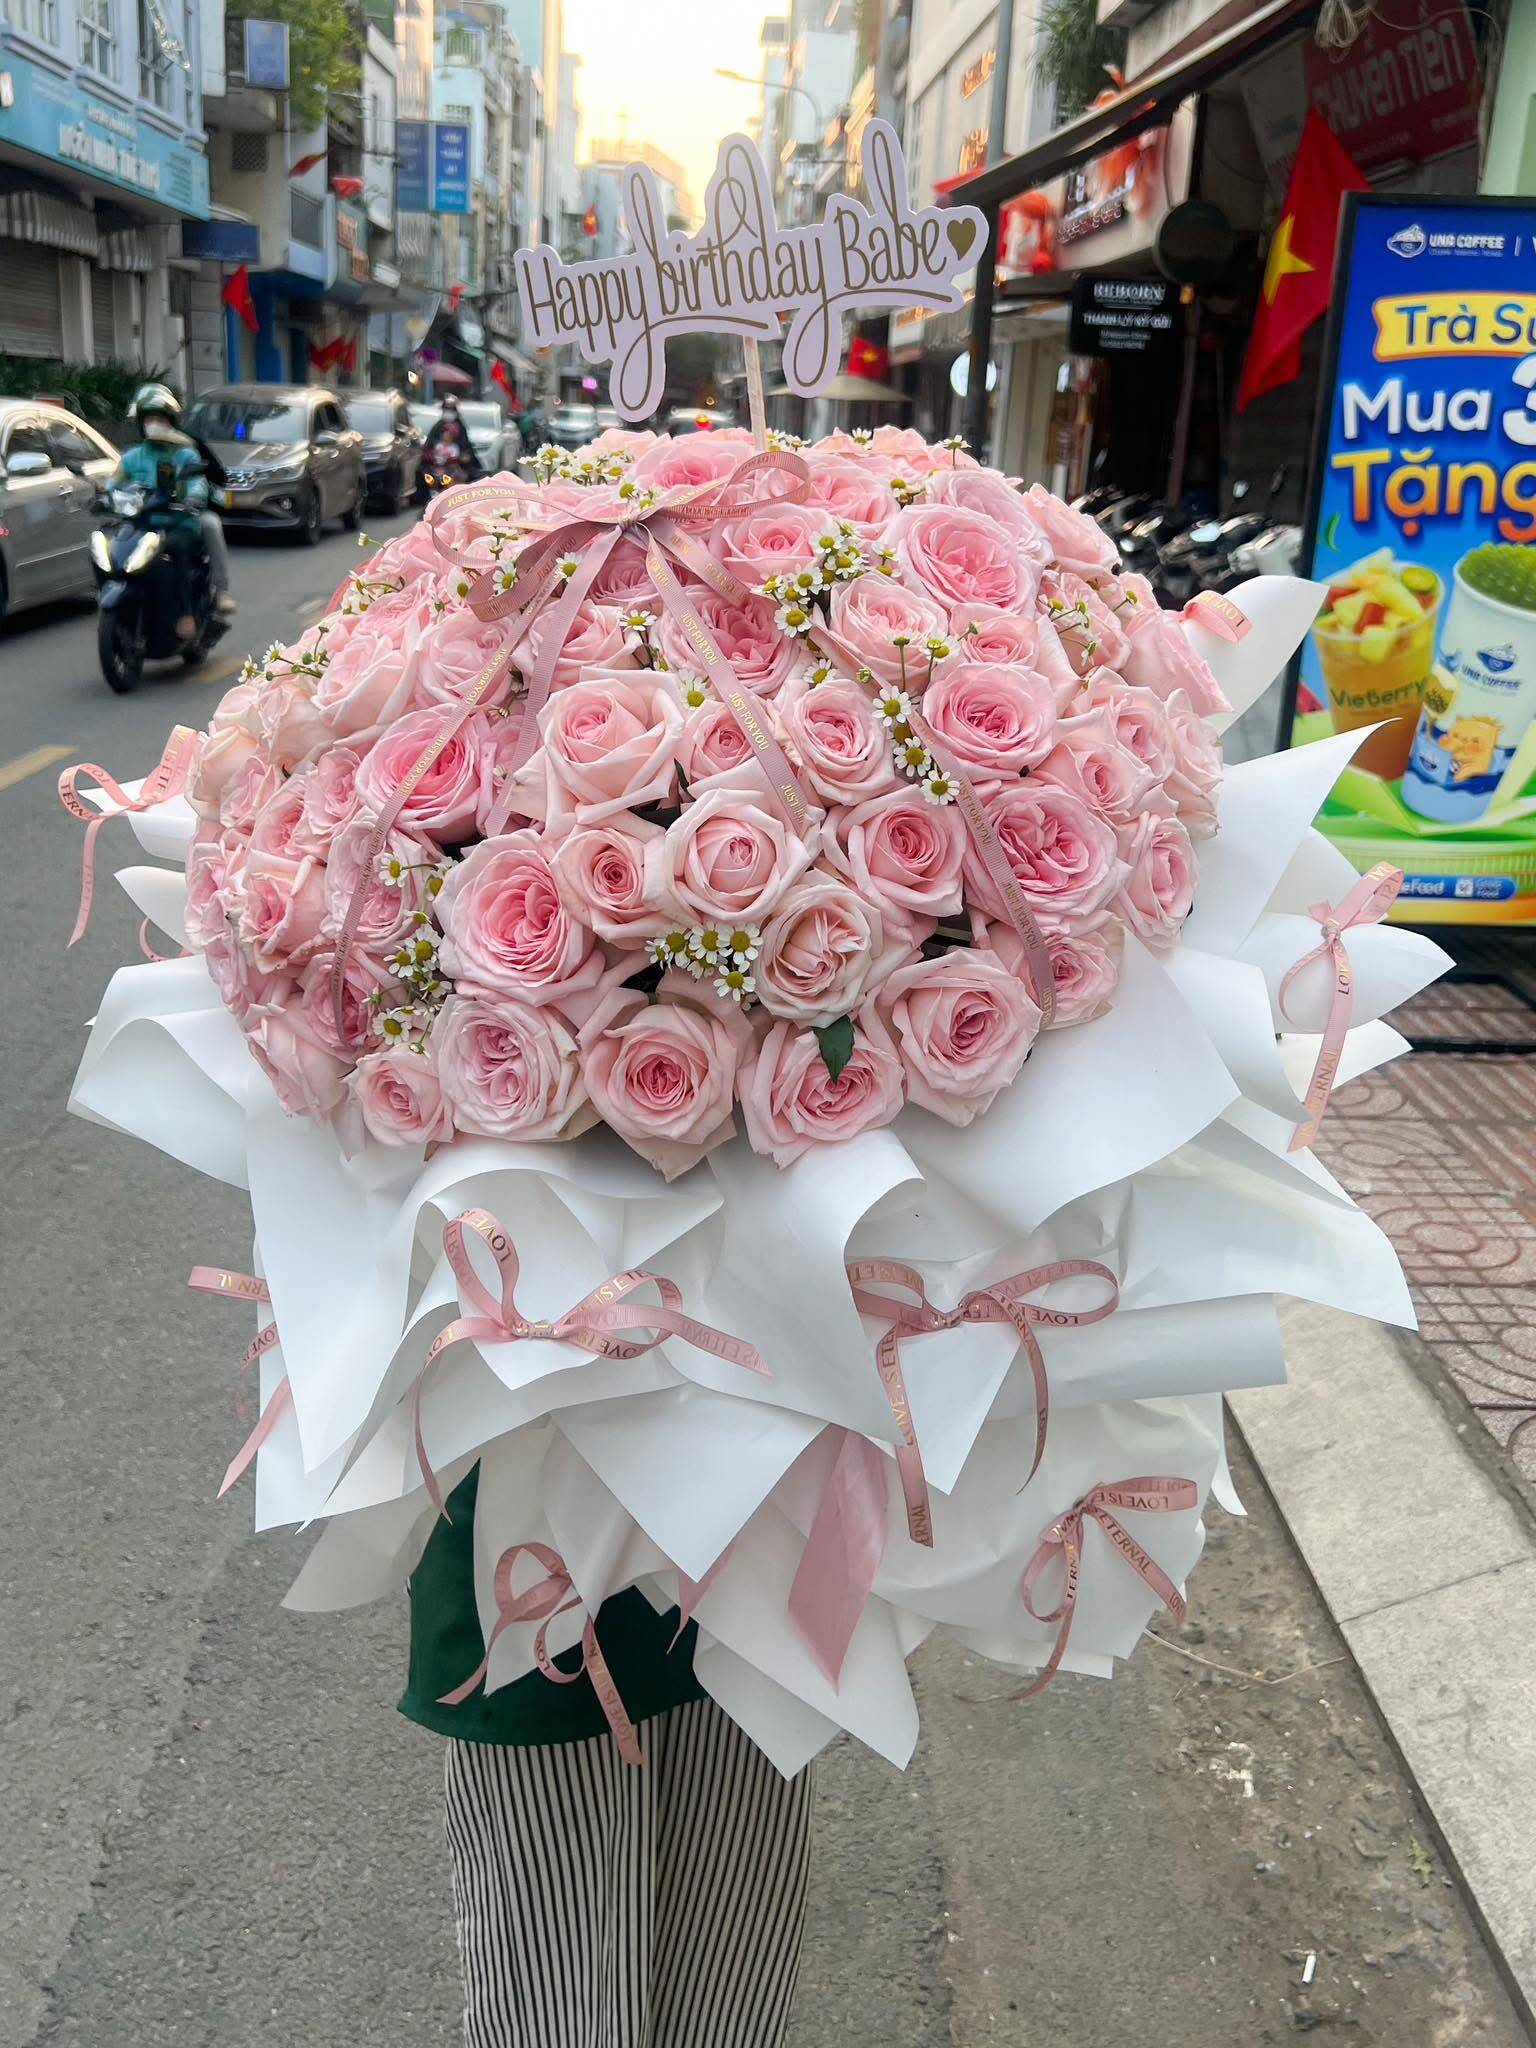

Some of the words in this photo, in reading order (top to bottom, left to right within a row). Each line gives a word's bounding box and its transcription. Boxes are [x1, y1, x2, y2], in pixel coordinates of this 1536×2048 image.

[836, 129, 947, 291] Babe
[1457, 234, 1505, 249] COFFEE
[631, 143, 925, 388] birthday
[522, 255, 745, 411] Happy
[1396, 304, 1476, 345] Trà
[1343, 378, 1493, 440] Mua
[447, 493, 471, 507] JUST
[472, 488, 493, 498] FOR
[492, 487, 516, 497] YOU
[1331, 448, 1536, 543] Tặng
[681, 612, 694, 633] JUST
[692, 629, 708, 649] FOR
[701, 643, 719, 666] YOU
[1330, 677, 1428, 708] VieBerry
[728, 692, 746, 714] JUST
[742, 710, 757, 732] FOR
[752, 726, 769, 752] YOU
[428, 735, 445, 755] JUST
[782, 784, 799, 809] JUST
[472, 1214, 512, 1263] LOVE
[1032, 1310, 1079, 1325] LOVE
[1108, 1493, 1123, 1503] IS
[1127, 1496, 1169, 1509] LOVE
[1099, 1514, 1150, 1574] ETERNAL
